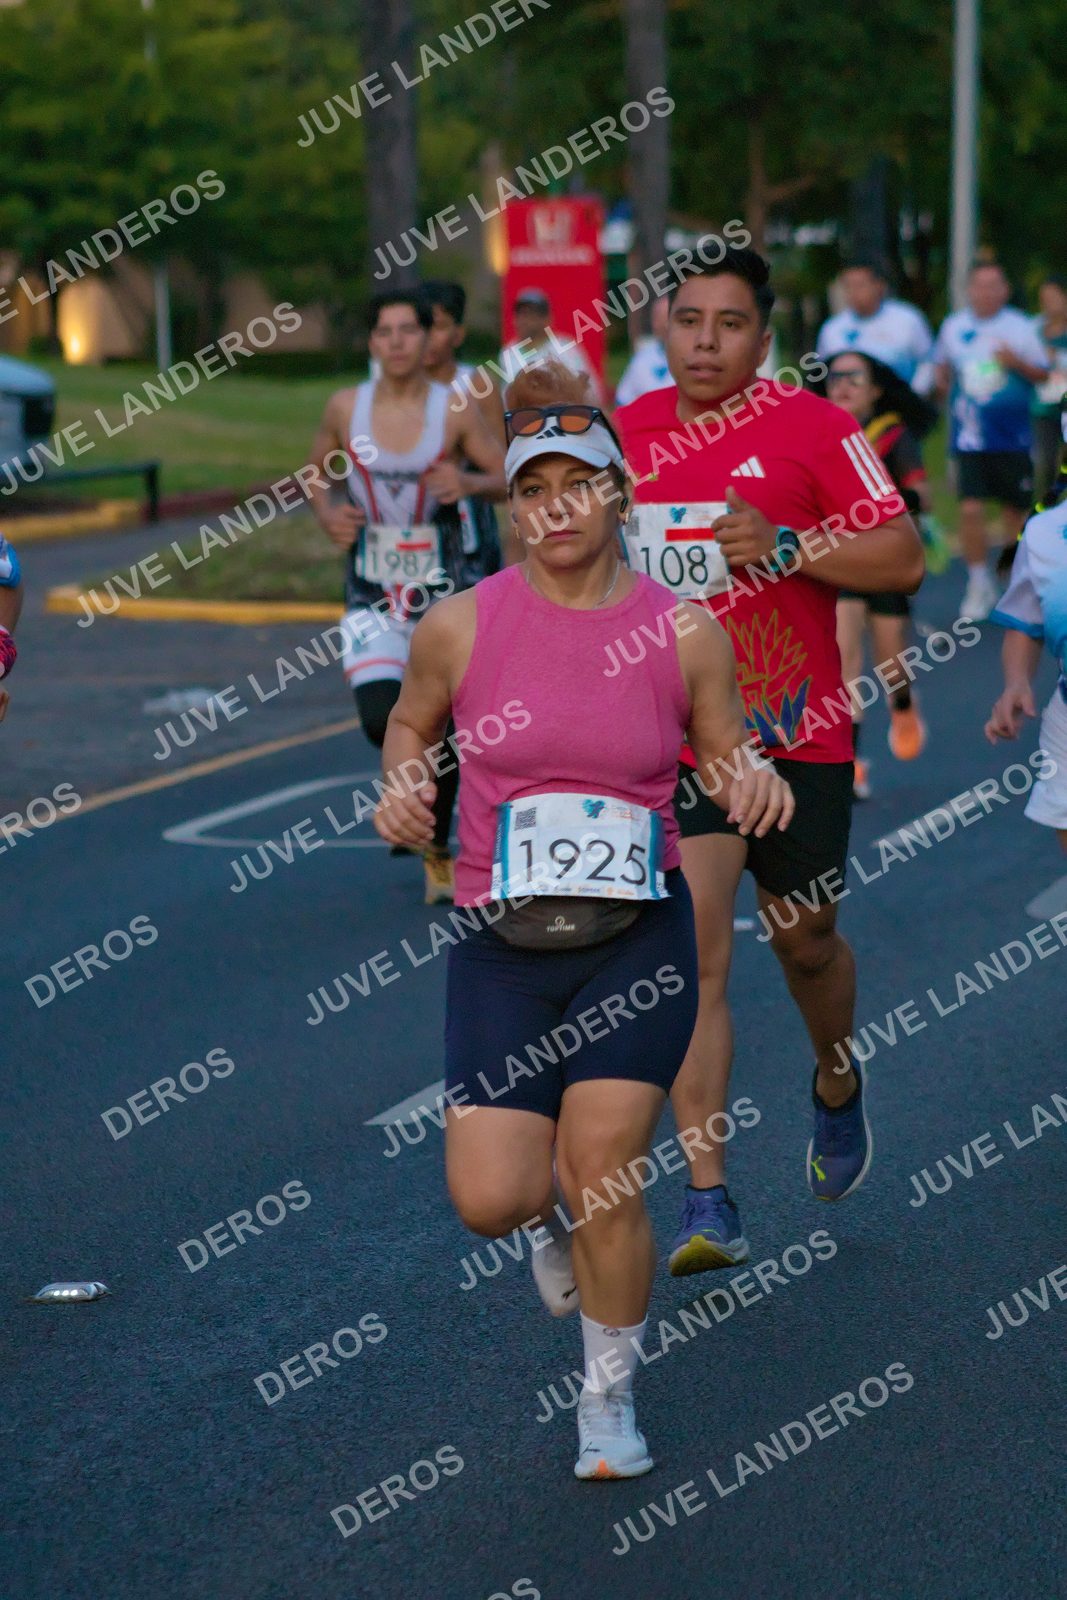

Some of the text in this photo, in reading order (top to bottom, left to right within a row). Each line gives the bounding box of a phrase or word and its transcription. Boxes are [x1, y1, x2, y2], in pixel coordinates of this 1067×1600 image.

[369, 550, 435, 577] 1987
[640, 545, 708, 587] 108
[519, 838, 646, 886] 1925
